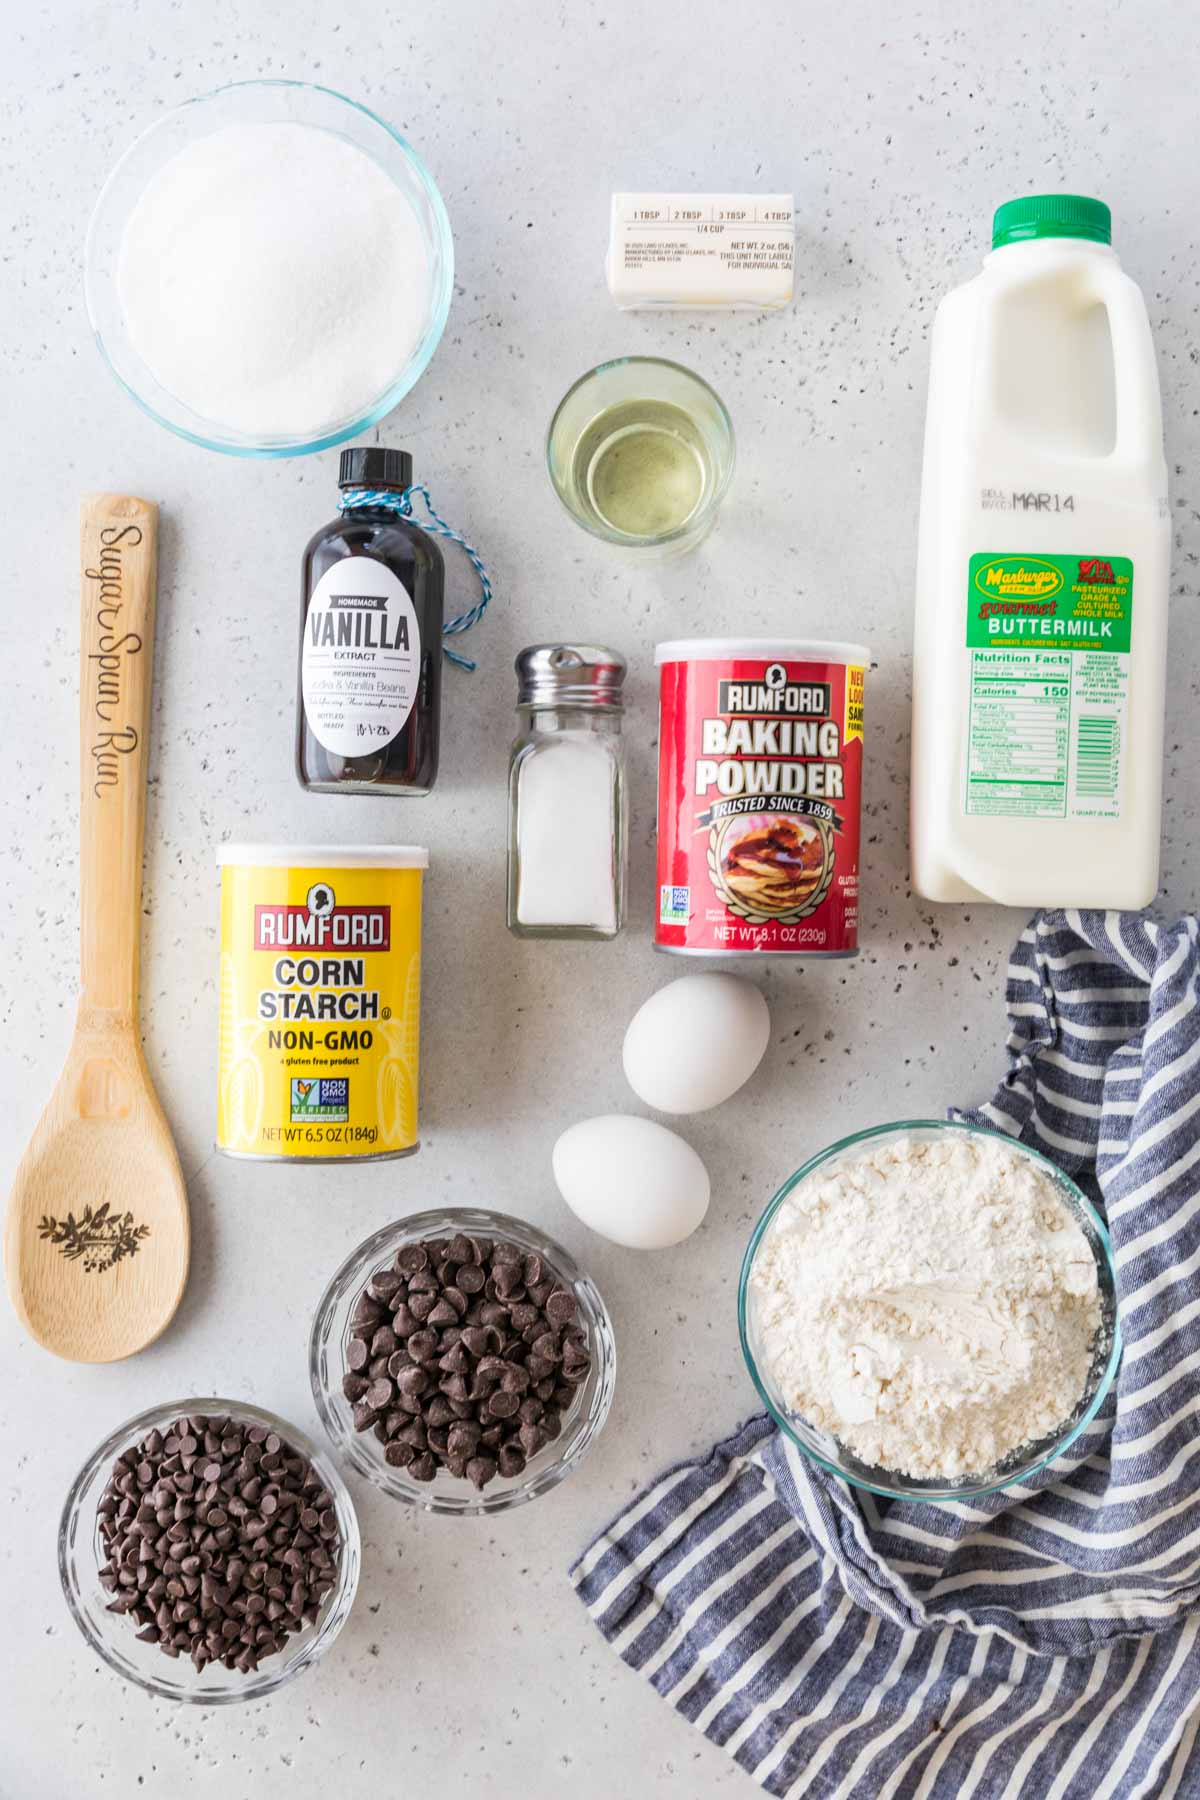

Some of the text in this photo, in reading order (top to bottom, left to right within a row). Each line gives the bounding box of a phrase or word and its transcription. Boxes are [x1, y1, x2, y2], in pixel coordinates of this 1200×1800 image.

[640, 211, 660, 219] TBSP
[675, 211, 680, 219] 2
[682, 211, 702, 219] TBSP
[764, 212, 769, 220] 4
[771, 212, 791, 220] TBSP
[697, 224, 724, 233] 1/4 CUP
[731, 242, 745, 250] NET
[760, 242, 766, 250] 2
[720, 252, 735, 260] THIS
[736, 252, 752, 260] UNIT
[753, 252, 767, 260] NOT
[727, 261, 741, 269] FOR
[742, 261, 779, 270] INDIVIDUAL
[985, 567, 1058, 588] Marburger
[1071, 585, 1127, 594] PASTEURIZED
[337, 598, 378, 608] HOMEMADE
[1080, 594, 1109, 602] GRADE
[978, 600, 1058, 619] gourmet
[1076, 602, 1120, 610] CULTURED
[311, 612, 410, 652] VANILLA
[988, 618, 1112, 637] BUTTERMILK
[334, 652, 377, 661] EXTRACT
[974, 653, 1071, 664] Nutrition Facts
[85, 526, 143, 799] Sugar Spun Run
[333, 670, 377, 679] INGREDIENTS
[344, 680, 375, 691] Vanilla
[376, 681, 407, 693] Beans
[974, 686, 1069, 697] Calories 150
[727, 685, 825, 714] RUMFORD
[702, 718, 840, 758] BAKING
[695, 759, 845, 799] POWDER
[713, 796, 834, 820] TRUSTED SINCE 1859
[260, 913, 384, 946] RUMFORD
[714, 927, 737, 940] NET
[761, 928, 777, 942] 8.1
[780, 928, 797, 942] OZ
[798, 928, 827, 945] (230g)
[275, 958, 364, 987] CORN
[259, 992, 379, 1021] STARCH
[268, 1030, 374, 1051] NON-GMO
[286, 1057, 311, 1067] gluten
[312, 1057, 328, 1065] free
[329, 1057, 359, 1067] product
[320, 1080, 347, 1089] NON
[320, 1088, 347, 1097] GMO
[320, 1095, 346, 1105] Project
[292, 1105, 346, 1114] VERIFIED
[262, 1125, 378, 1144] NET WT 6.5 OZ (184g)
